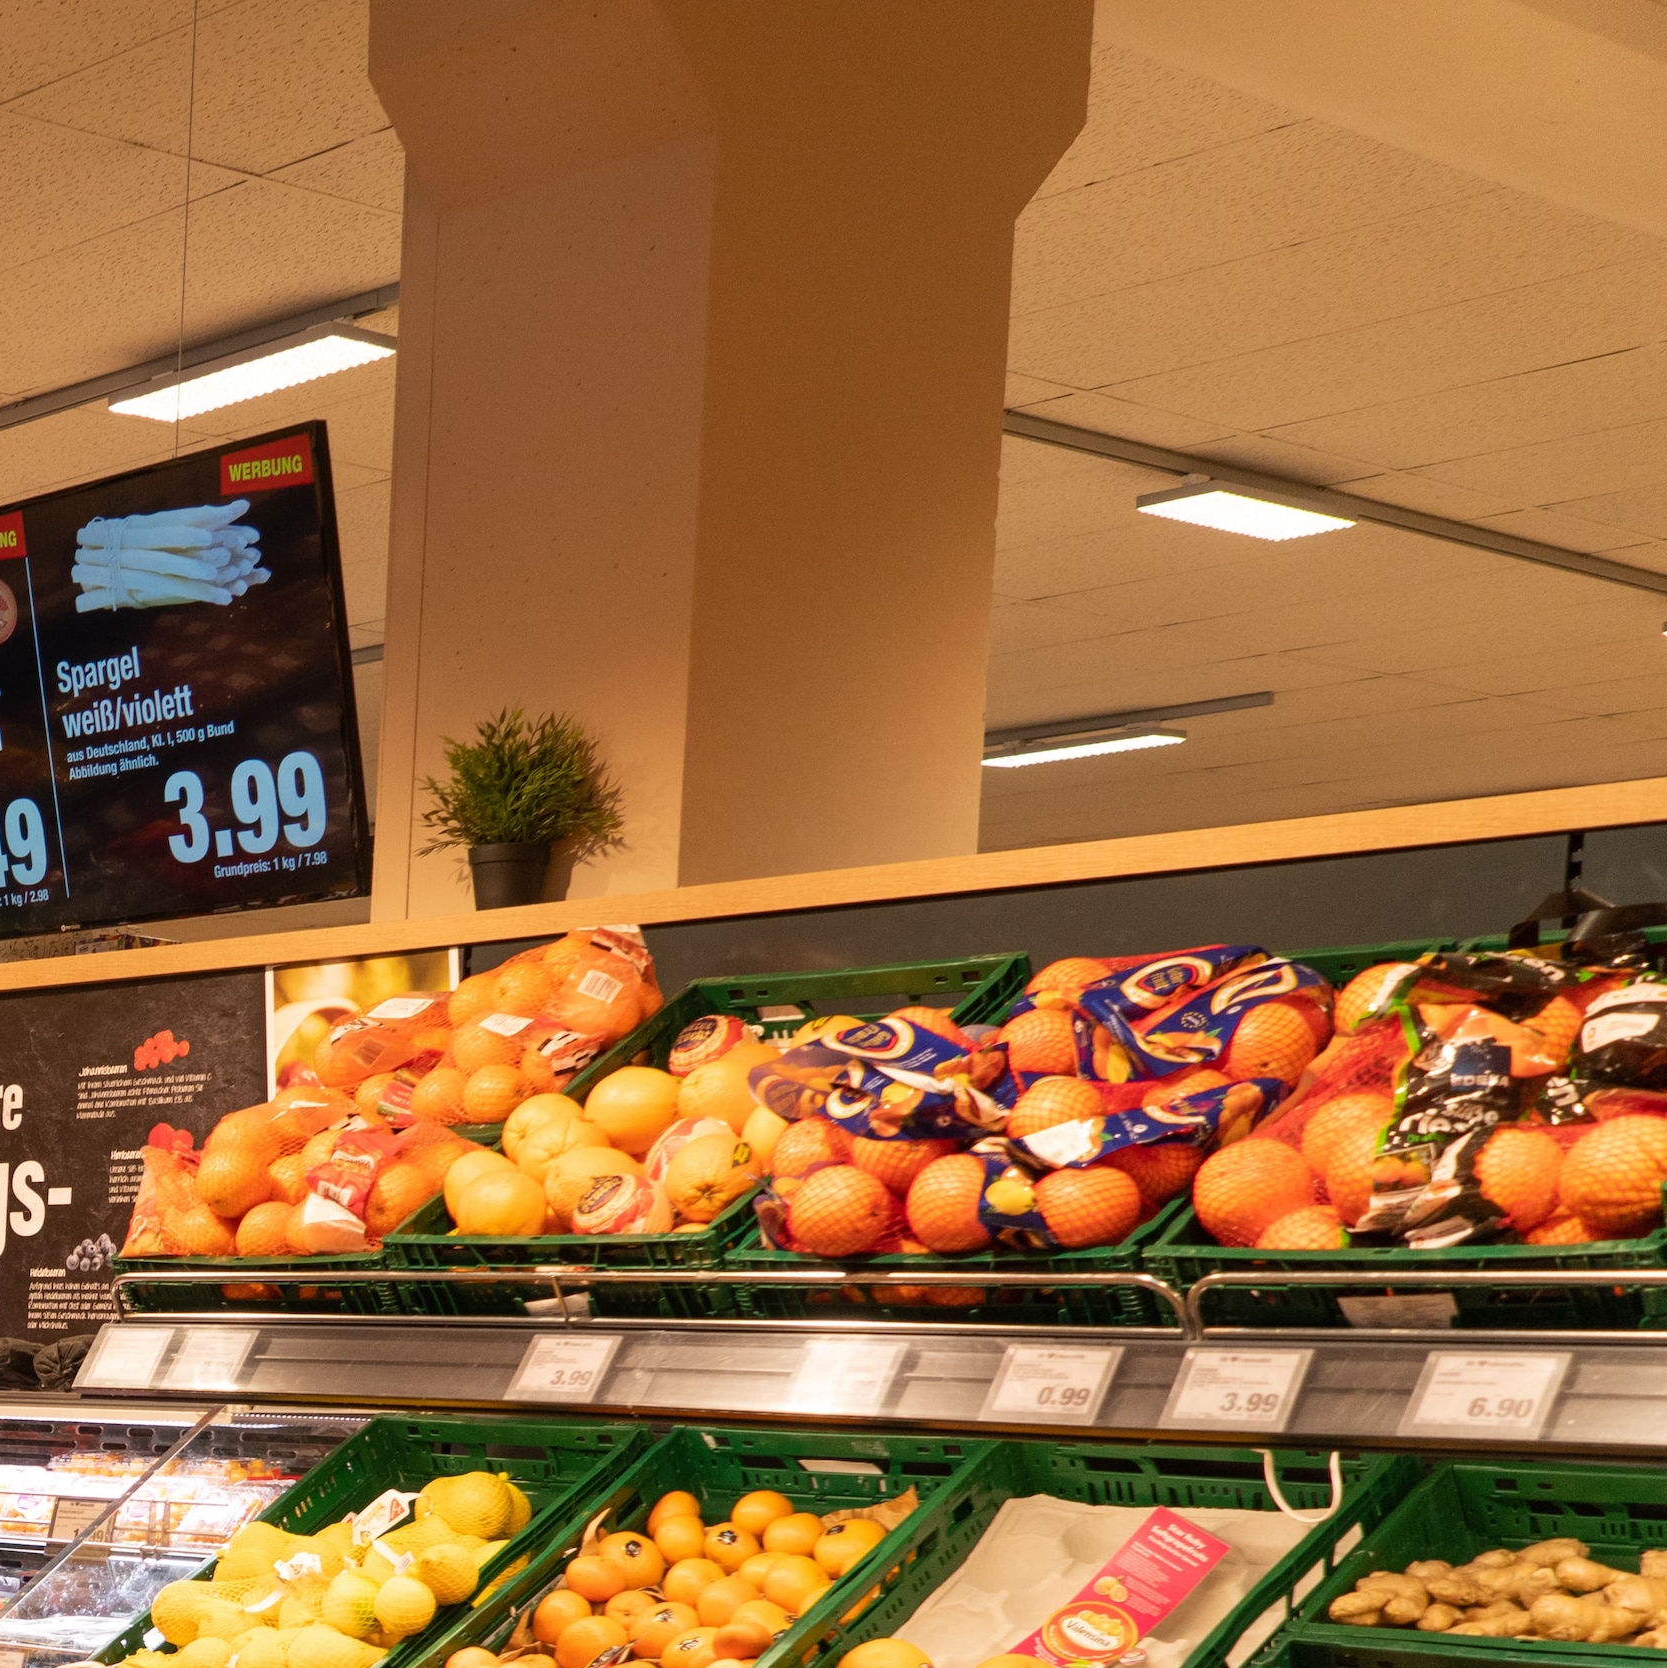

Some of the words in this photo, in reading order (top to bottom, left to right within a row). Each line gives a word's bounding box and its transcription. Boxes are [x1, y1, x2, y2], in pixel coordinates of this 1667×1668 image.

[228, 454, 303, 483] WERBUNG
[56, 646, 141, 693] Spargel
[62, 685, 194, 738] weiß/violett
[66, 749, 84, 763] aus
[86, 735, 150, 759] Deutschland,
[151, 732, 165, 747] Kl.
[176, 728, 197, 744] 500
[198, 729, 206, 743] g
[207, 721, 235, 739] Bund
[68, 762, 118, 781] Abbildung
[119, 754, 159, 773] ähnlich.
[163, 750, 328, 865] 3.99
[213, 860, 271, 880] Grundpreis:
[280, 856, 295, 874] kg
[304, 851, 328, 867] 7.98
[9, 892, 23, 909] kg
[29, 888, 49, 904] 2.98
[551, 1369, 593, 1386] 3.99
[1037, 1385, 1091, 1406] 0.99
[1219, 1392, 1279, 1412] 3.99
[1467, 1397, 1534, 1419] 6.90
[1066, 1619, 1111, 1648] Valensina
